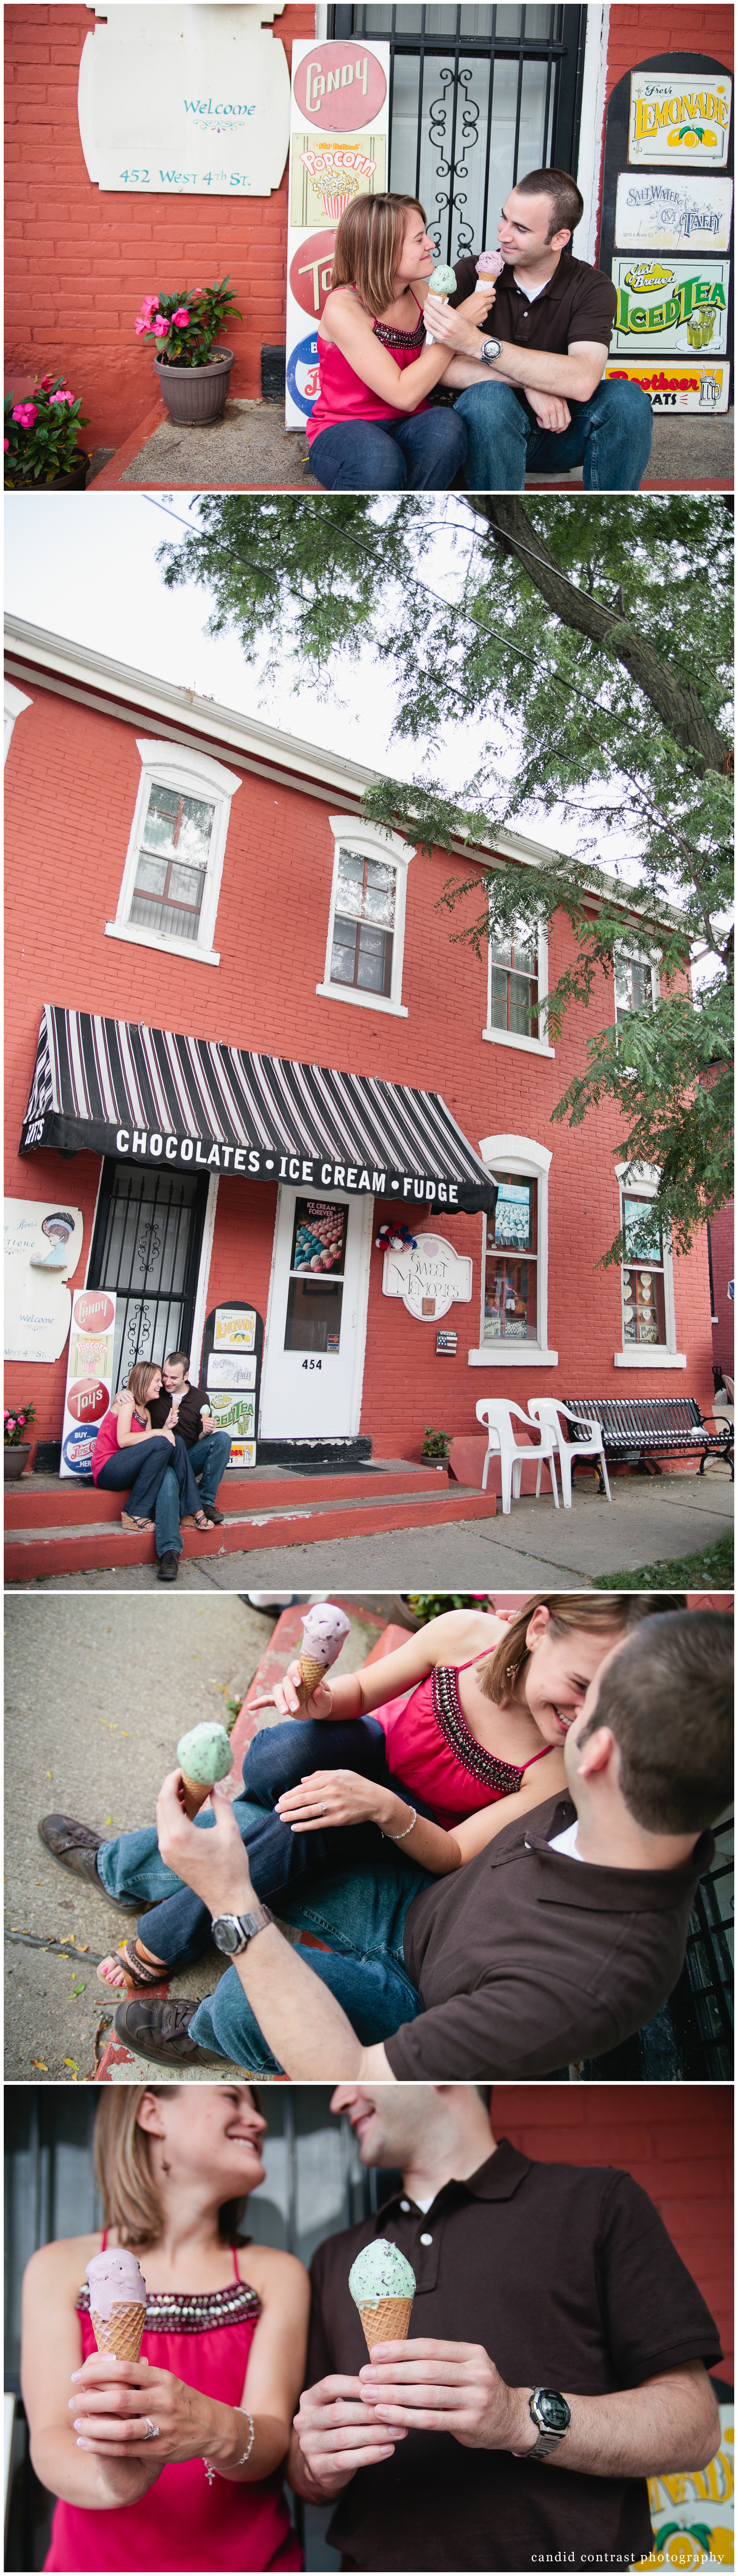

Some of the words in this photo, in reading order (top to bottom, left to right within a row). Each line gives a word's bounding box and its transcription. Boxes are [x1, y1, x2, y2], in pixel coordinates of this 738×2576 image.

[306, 57, 368, 112] CANDY
[645, 85, 672, 96] Fresh
[183, 98, 256, 115] Welcome
[632, 92, 729, 142] LEMONADE
[119, 169, 150, 183] 452
[159, 170, 200, 184] West
[626, 187, 652, 207] SALT
[649, 184, 685, 206] WATER
[680, 211, 725, 238] TAFFY
[628, 260, 656, 282] Just
[633, 271, 677, 287] Brewed
[615, 287, 680, 333] ICED
[674, 274, 727, 325] TEA
[116, 1130, 260, 1172] CHOCOLATES
[279, 1156, 313, 1181] ICE
[321, 1164, 386, 1192] CREAM
[403, 1177, 458, 1203] FUDGE
[12, 1219, 38, 1231] River's
[409, 1254, 450, 1277] SWEET
[391, 1264, 459, 1298] MEMORIES
[20, 1315, 54, 1324] Welcome
[79, 1299, 107, 1324] CANDY
[215, 1319, 255, 1340] LEMONADE
[484, 1321, 499, 1330] ootbeer
[507, 1320, 525, 1331] Popcorn
[222, 1359, 236, 1368] WATER
[302, 1359, 322, 1370] 454
[234, 1371, 252, 1382] TAFFY
[71, 1383, 103, 1417] Toys
[212, 1394, 225, 1404] Just
[232, 1400, 254, 1424] TEA
